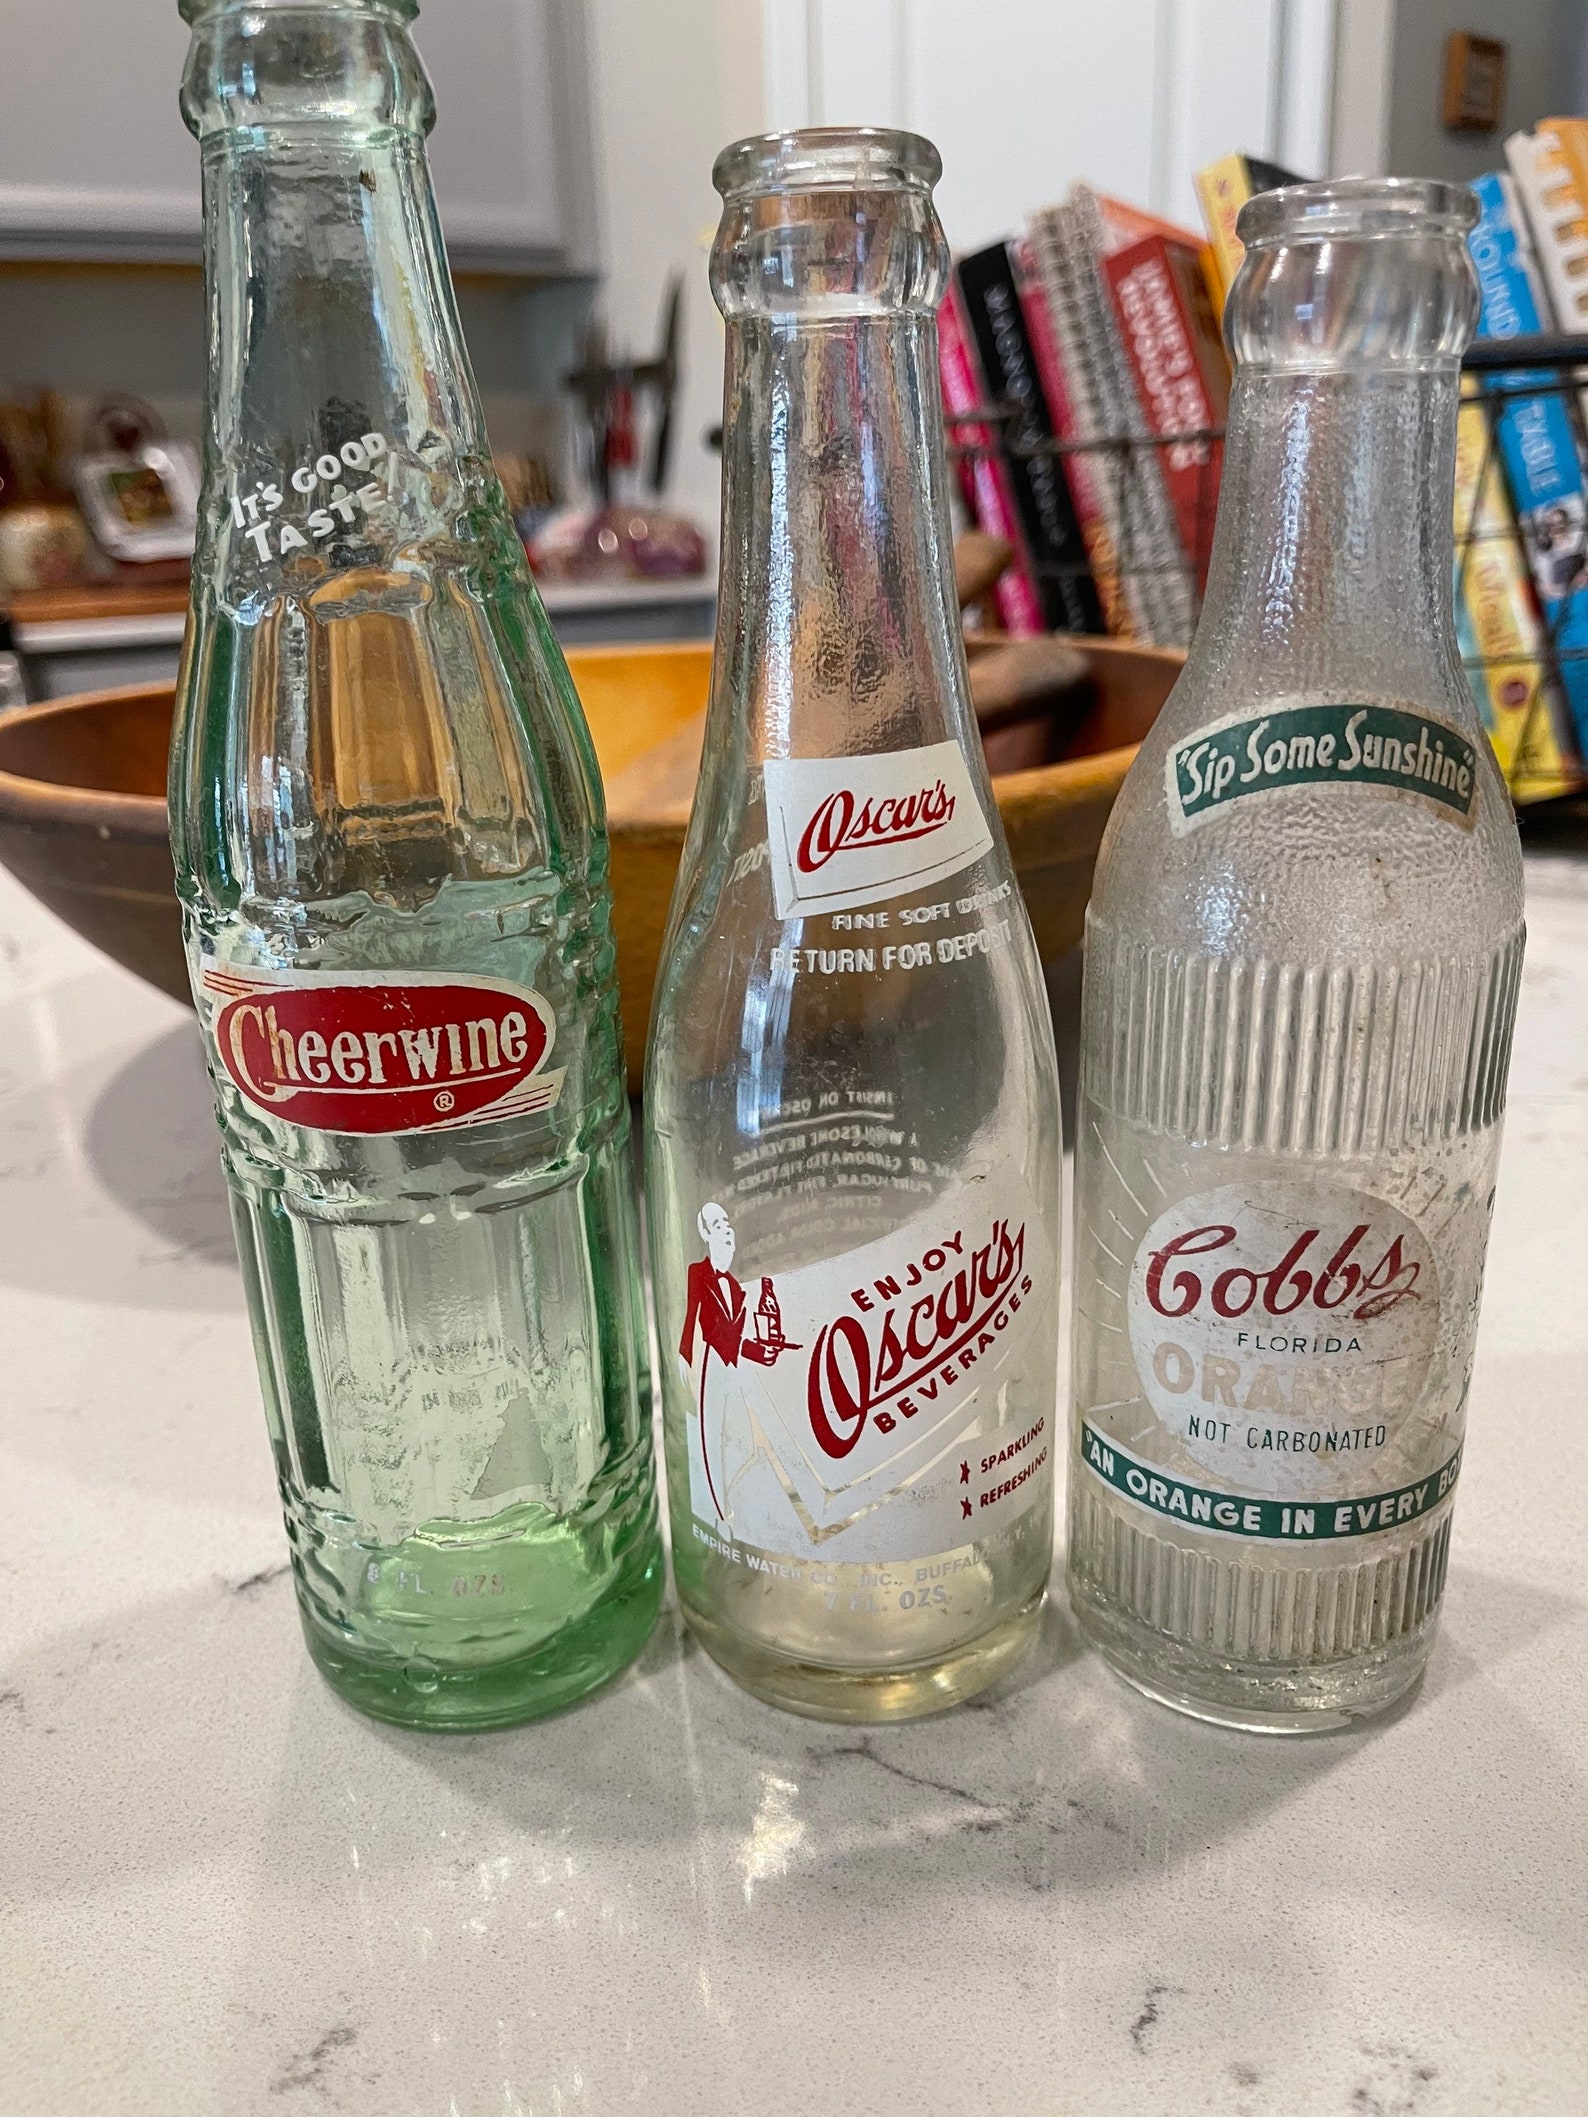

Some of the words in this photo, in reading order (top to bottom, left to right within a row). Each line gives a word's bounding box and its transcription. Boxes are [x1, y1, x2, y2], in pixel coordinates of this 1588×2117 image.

[291, 432, 388, 494] GOOD
[1240, 719, 1337, 783] Some
[796, 779, 956, 874] Oscar's
[831, 911, 891, 931] FINE
[898, 902, 951, 927] SOFT
[769, 947, 877, 975] RETURN
[881, 942, 933, 971] FOR
[229, 1004, 528, 1102] Cheerwine
[850, 1230, 964, 1312] ENJOY
[807, 1218, 1026, 1460] Oscar's
[873, 1274, 1033, 1435] BEVERAGES
[1237, 1332, 1363, 1354] FLORIDA
[980, 1416, 1045, 1474] SPARKLING
[1187, 1414, 1232, 1444] NOT
[1246, 1424, 1386, 1453] CARBONATED
[980, 1445, 1048, 1508] REFRESHING
[1124, 1468, 1262, 1532] ORANGE
[1280, 1507, 1316, 1536] IN
[1333, 1483, 1429, 1534] EVERY
[692, 1523, 742, 1564] EMPIRE
[746, 1553, 802, 1580] WATER
